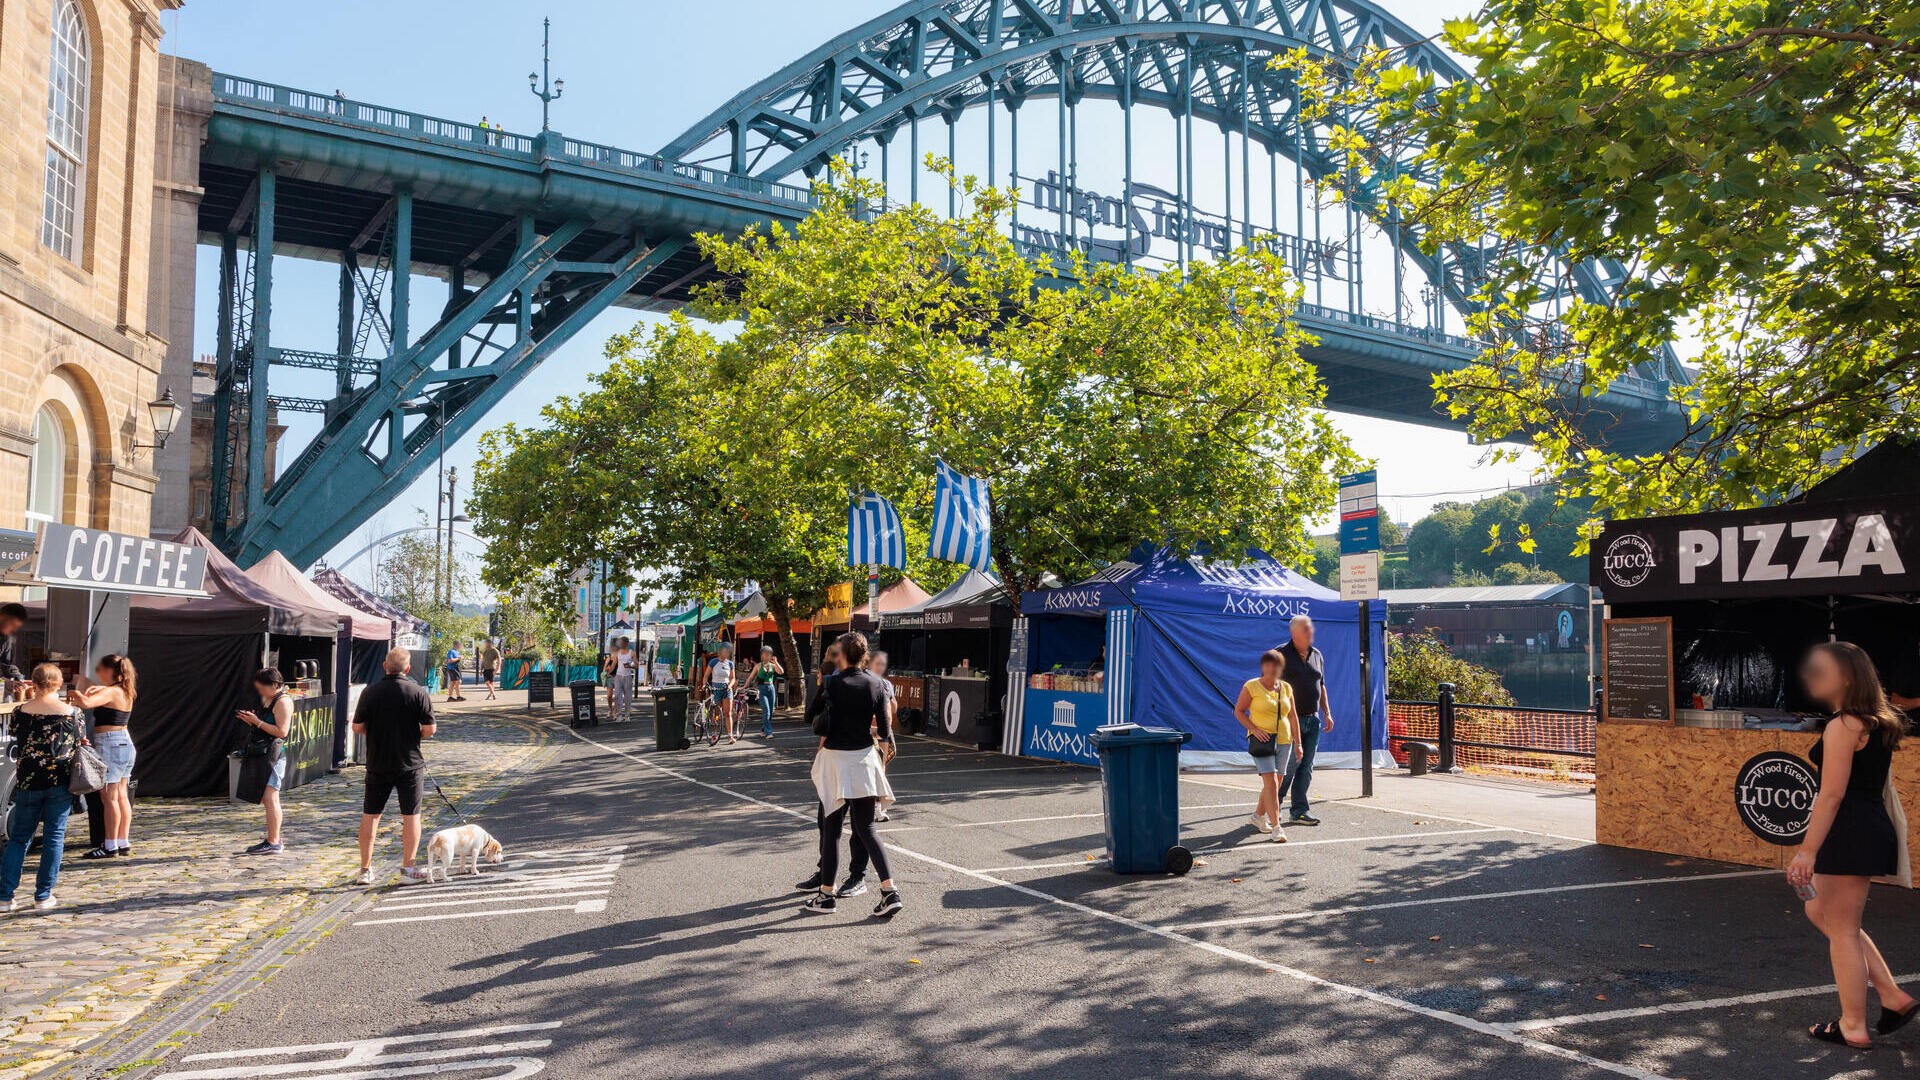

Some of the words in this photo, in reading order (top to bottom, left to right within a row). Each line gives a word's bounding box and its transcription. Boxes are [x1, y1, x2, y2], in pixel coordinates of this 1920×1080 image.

[64, 528, 192, 589] COFFEE
[1678, 513, 1906, 585] PIZZA
[1603, 553, 1657, 570] LUCCA
[1044, 591, 1101, 610] ACROPOLIS
[1223, 593, 1310, 616] ACROPOLIS
[284, 705, 334, 748] ENOBIA
[1753, 763, 1781, 779] Wood
[1784, 765, 1808, 784] fired
[1757, 814, 1785, 834] Pizza
